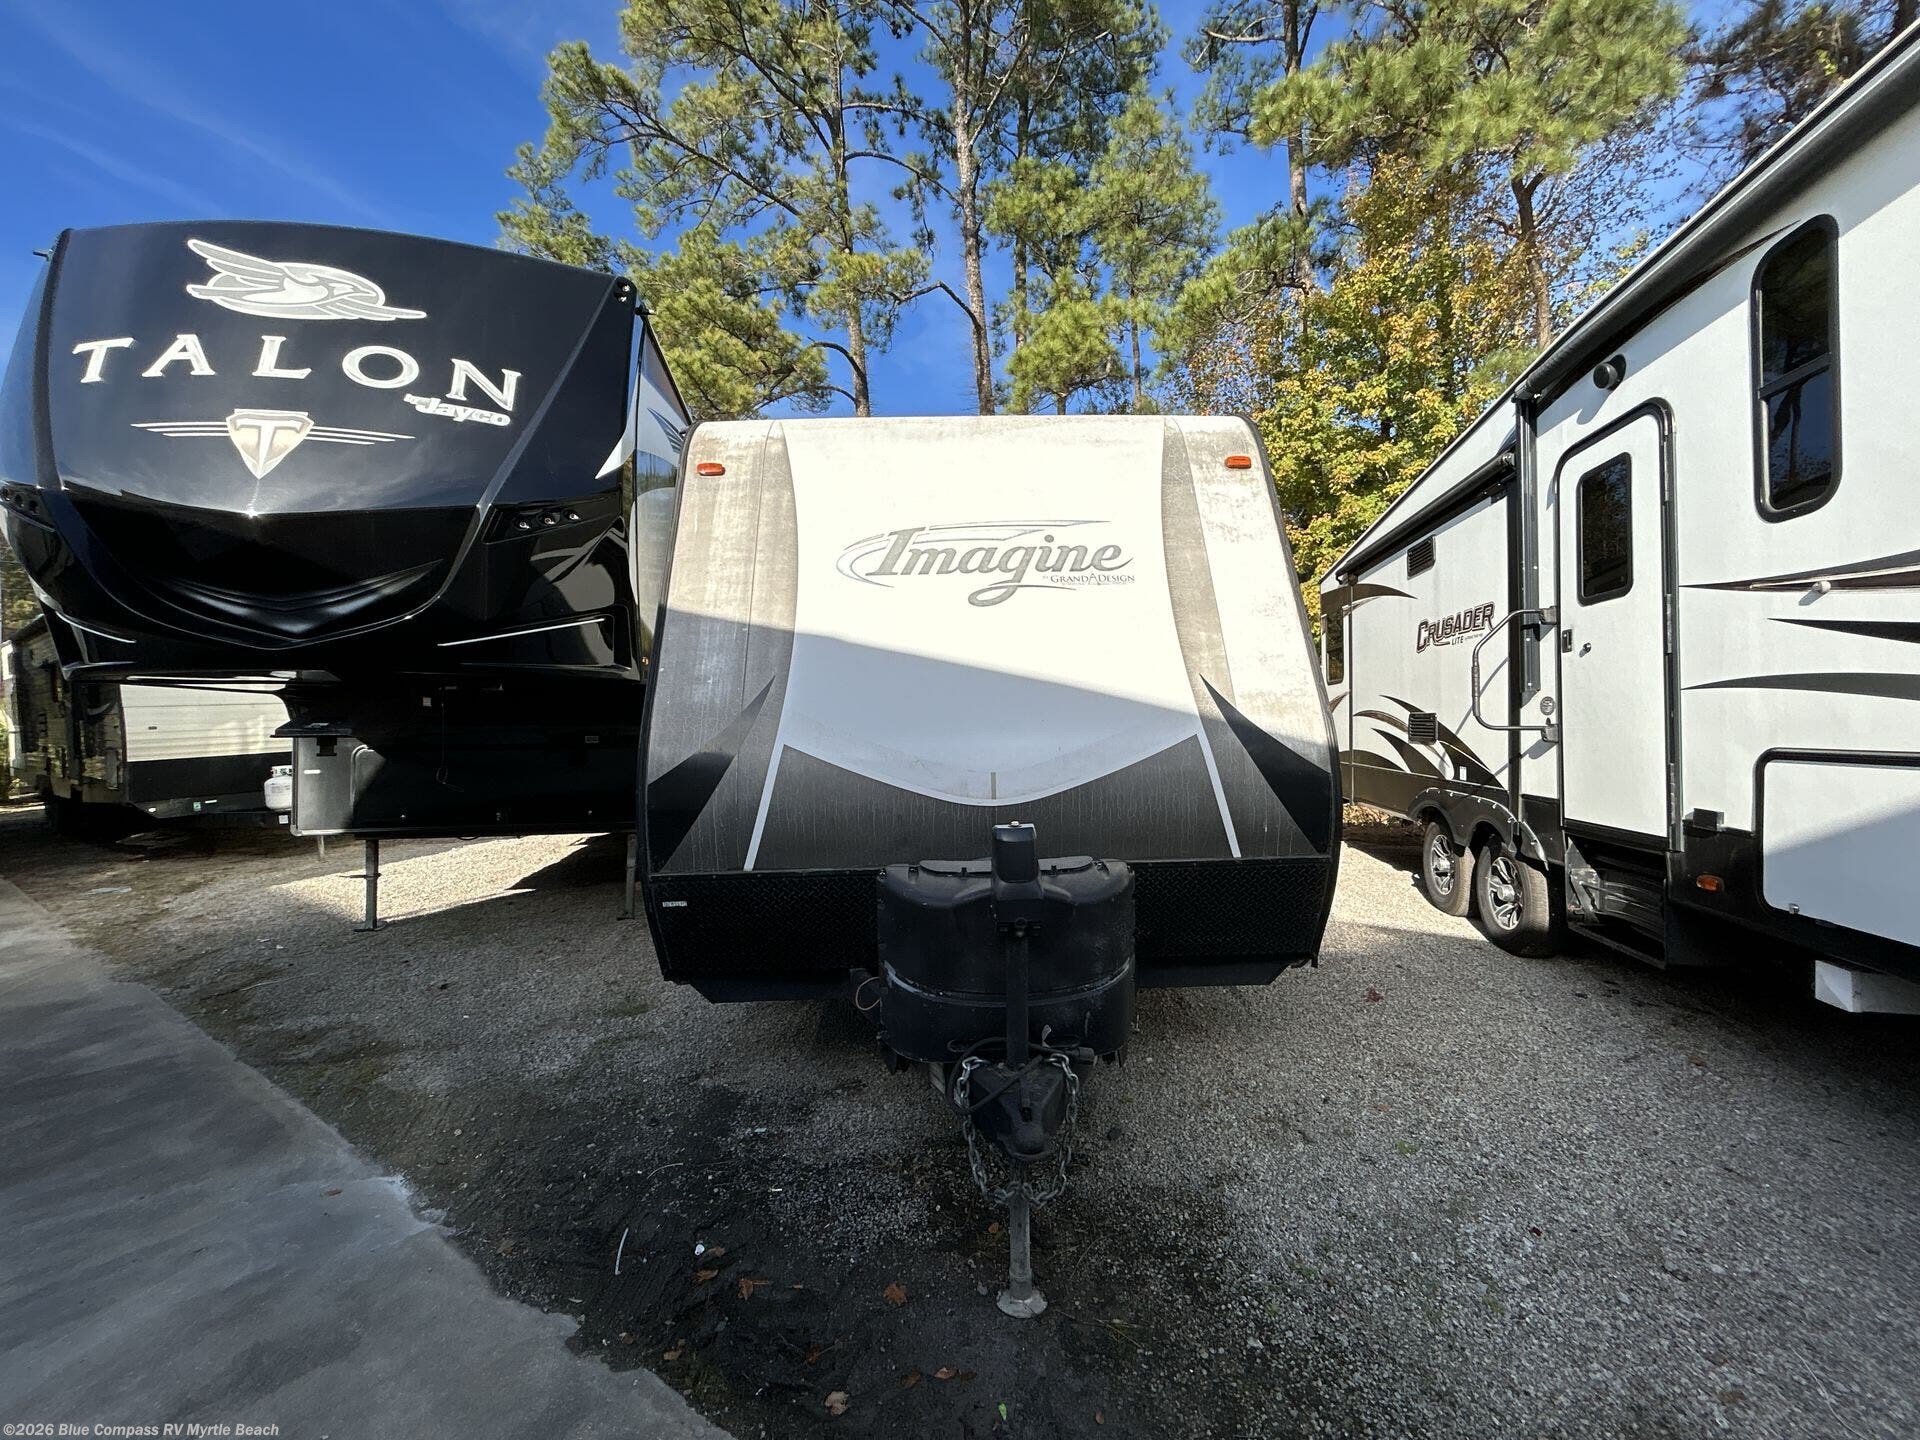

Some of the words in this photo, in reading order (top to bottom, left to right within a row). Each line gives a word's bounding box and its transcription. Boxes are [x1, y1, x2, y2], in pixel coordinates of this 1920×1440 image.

[72, 333, 522, 411] TALON
[415, 397, 511, 426] Jayco
[865, 526, 1134, 607] Imagine
[1416, 601, 1495, 654] CRUSADER
